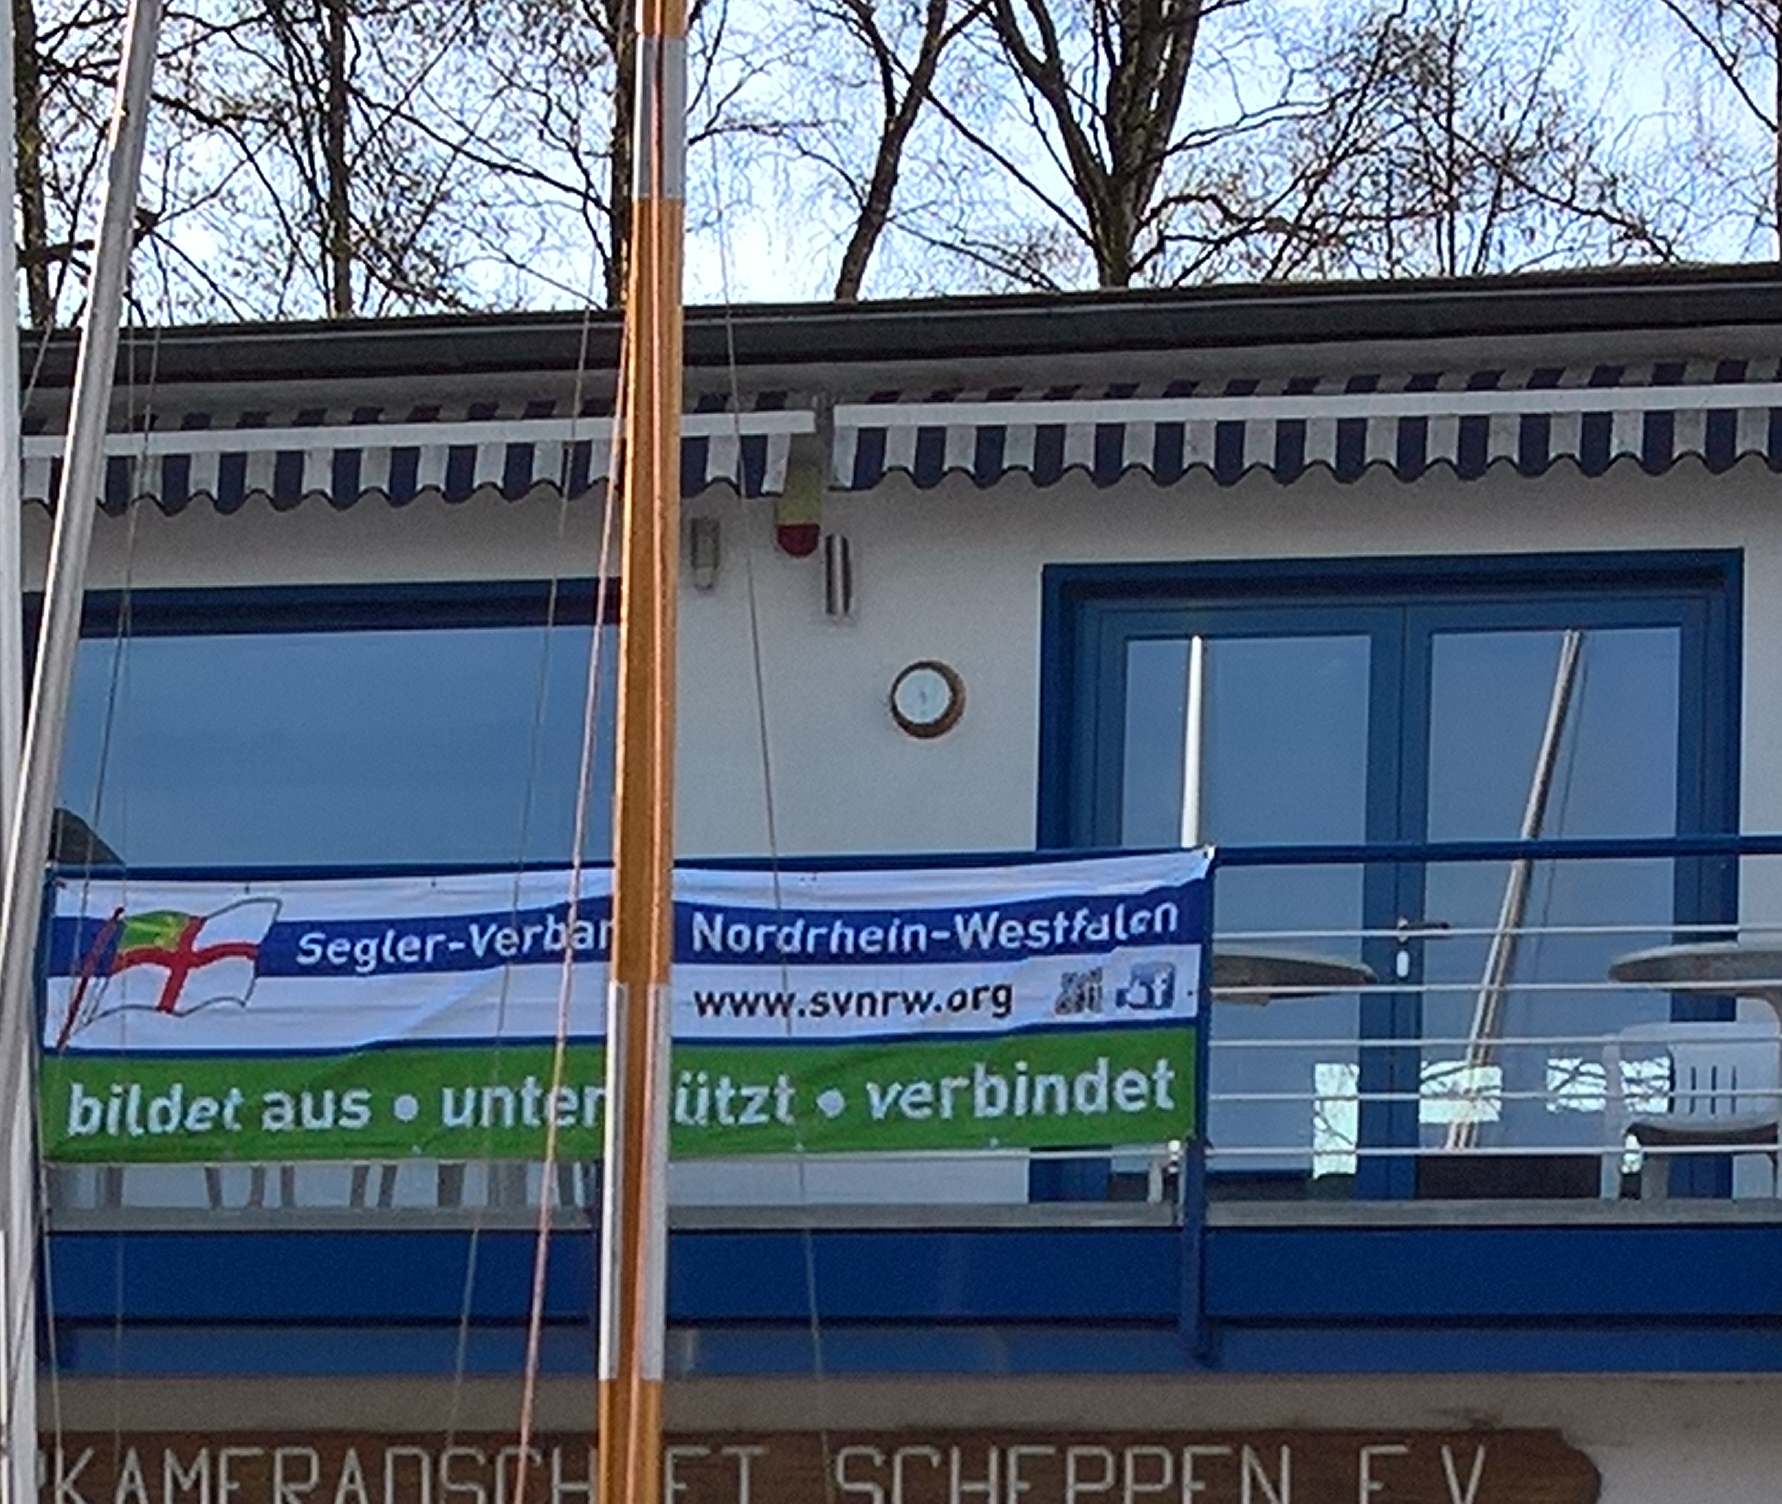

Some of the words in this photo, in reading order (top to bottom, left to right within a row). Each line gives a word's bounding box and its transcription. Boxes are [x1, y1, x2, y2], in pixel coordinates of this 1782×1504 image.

[692, 901, 1179, 954] Nordrhein-Westfalen
[692, 981, 1015, 1018] www.svnrw.org
[66, 1079, 245, 1138] bildet
[261, 1085, 373, 1132] aus
[441, 1070, 796, 1130] unterützt
[865, 1057, 1177, 1120] verbindet
